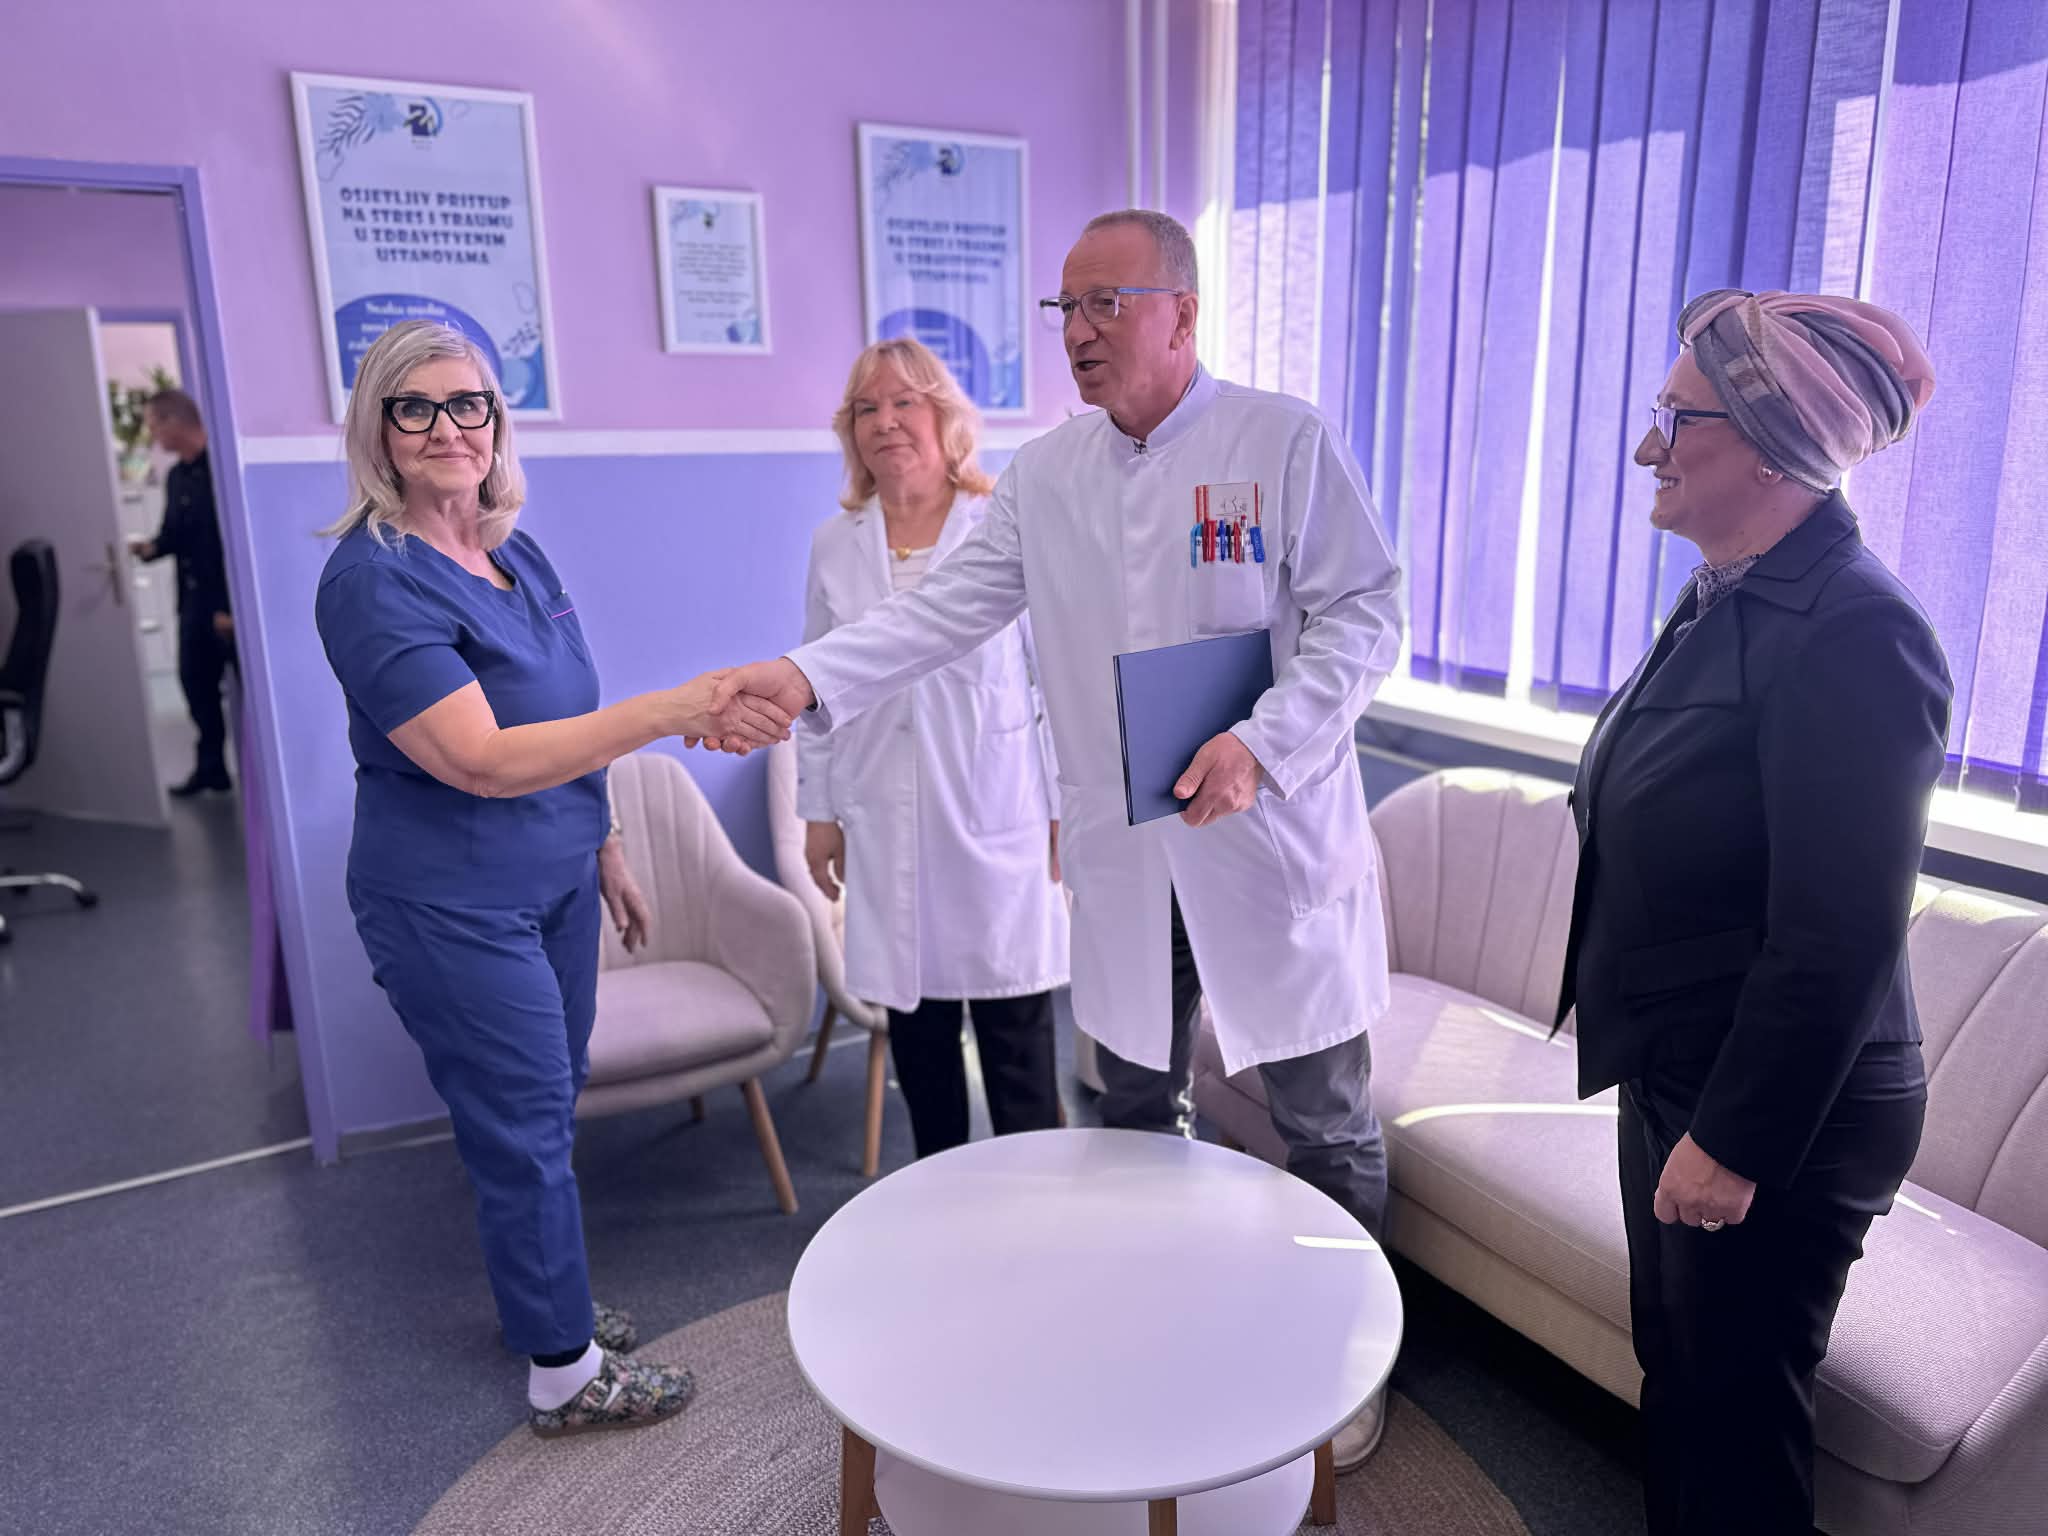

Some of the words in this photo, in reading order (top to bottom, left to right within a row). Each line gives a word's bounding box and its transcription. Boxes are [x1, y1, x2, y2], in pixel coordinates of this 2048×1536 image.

[436, 192, 511, 209] PRISTUP
[342, 207, 366, 222] NA
[371, 209, 424, 224] STRES
[440, 212, 513, 229] TRAUMU
[354, 227, 367, 242] U
[371, 228, 506, 246] ZDRAVSTVENIM
[376, 247, 490, 265] USTANOVAMA
